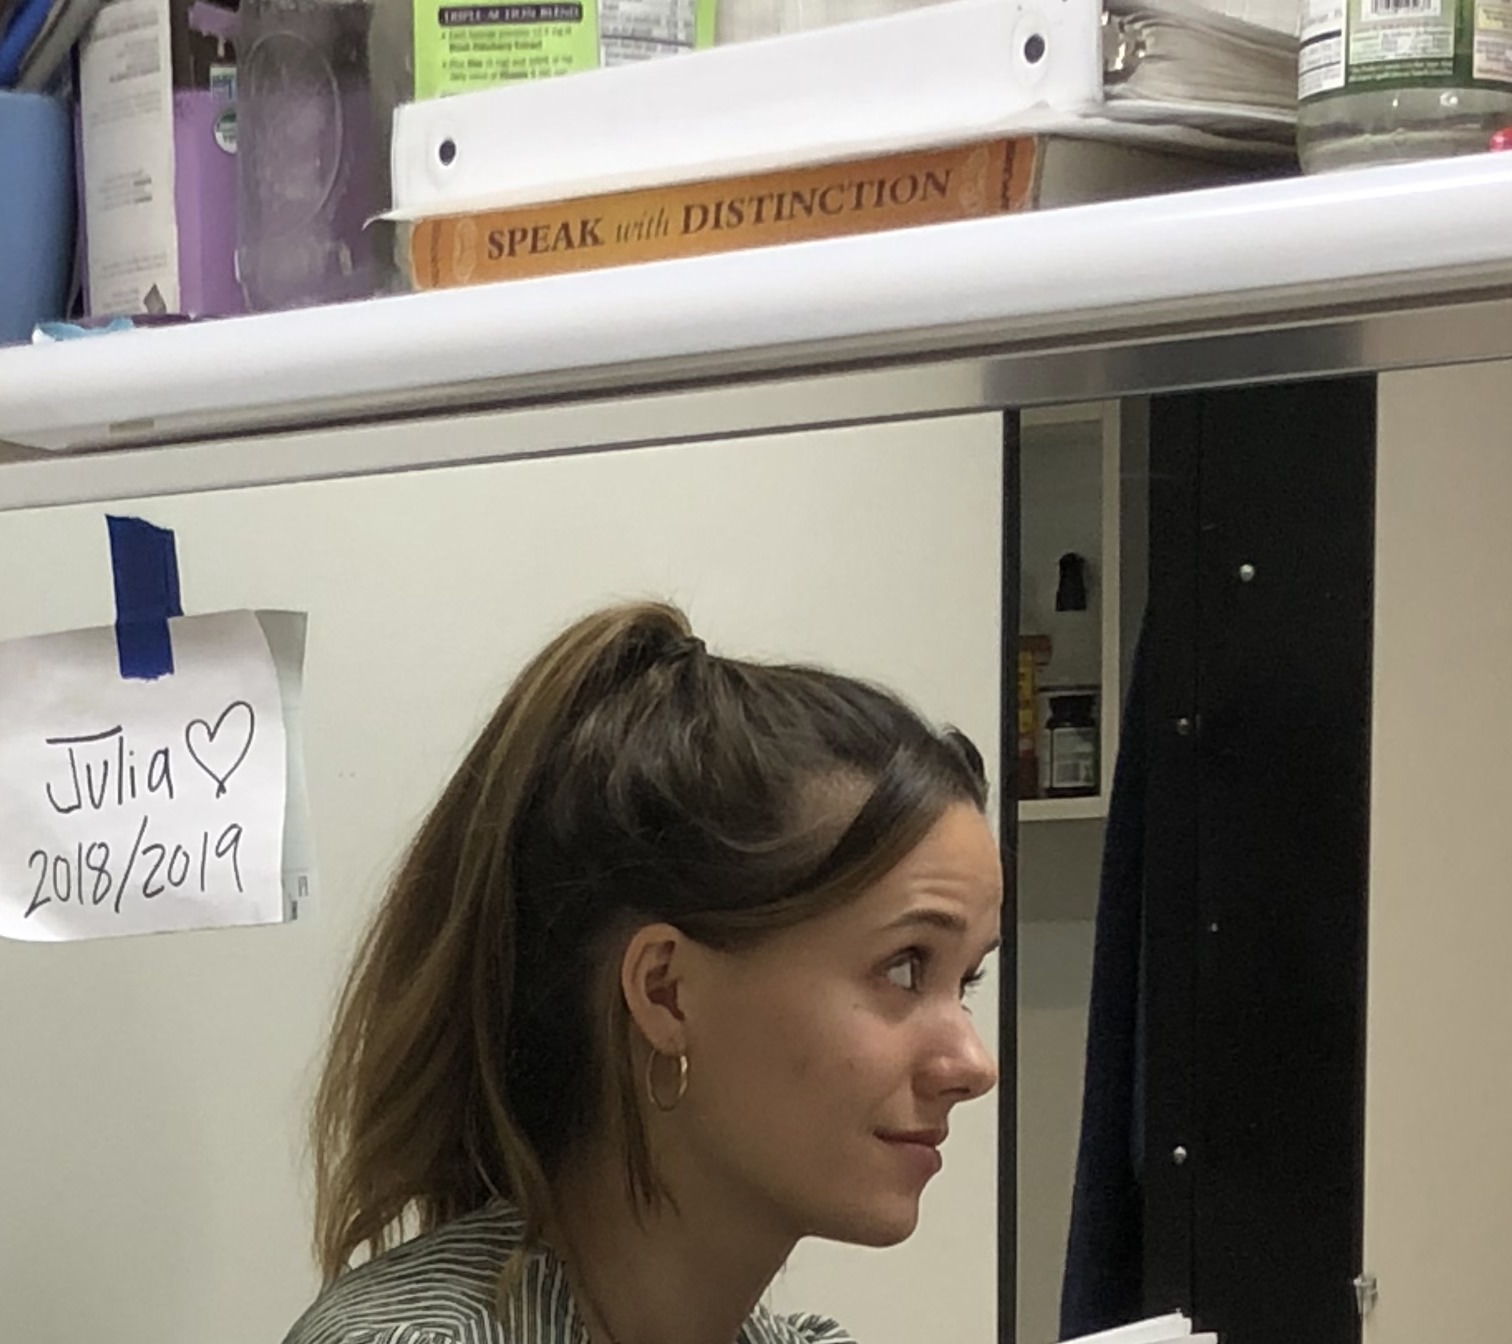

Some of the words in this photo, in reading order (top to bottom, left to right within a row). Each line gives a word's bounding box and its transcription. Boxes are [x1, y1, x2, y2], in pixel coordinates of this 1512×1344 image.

[488, 217, 604, 261] SPEAK
[616, 206, 669, 244] with
[681, 169, 953, 235] DISTINCTION
[45, 725, 173, 814] Julia
[24, 815, 244, 918] 2018/2019
